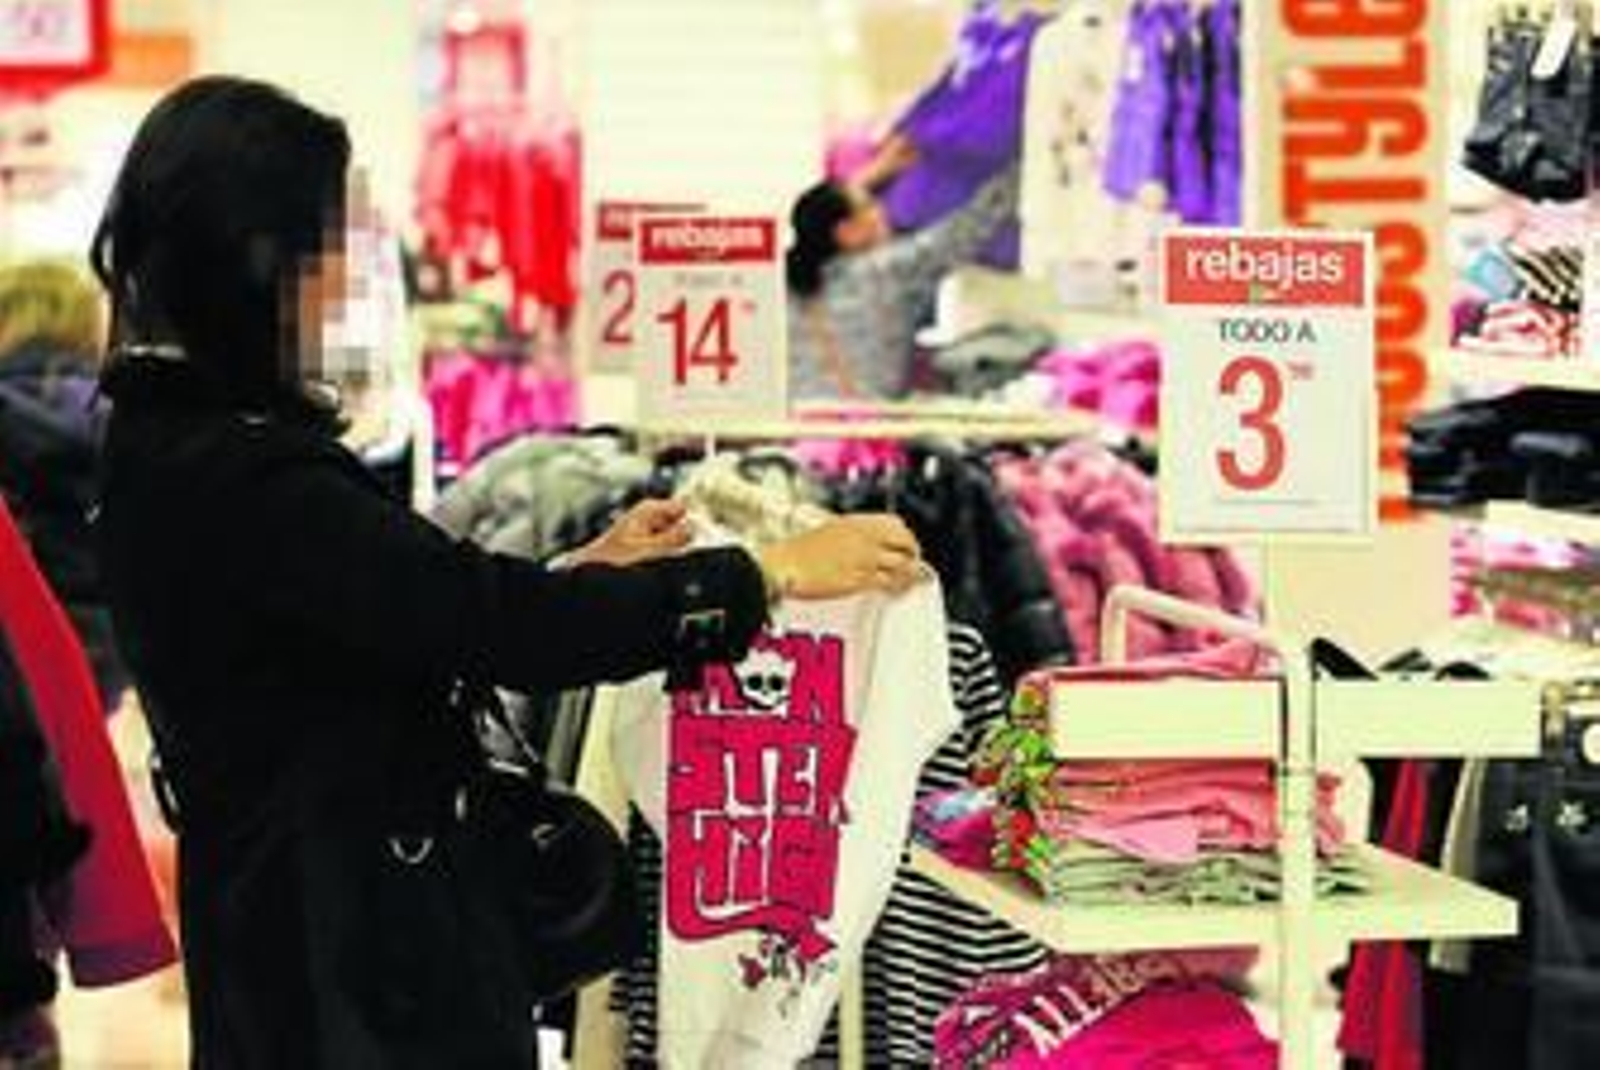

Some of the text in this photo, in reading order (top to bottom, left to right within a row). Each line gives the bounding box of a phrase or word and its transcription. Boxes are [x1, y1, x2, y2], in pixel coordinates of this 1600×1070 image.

[1186, 240, 1344, 290] rebajas
[656, 298, 739, 386] 14
[1219, 318, 1316, 343] TODO A
[1217, 355, 1285, 491] 3
